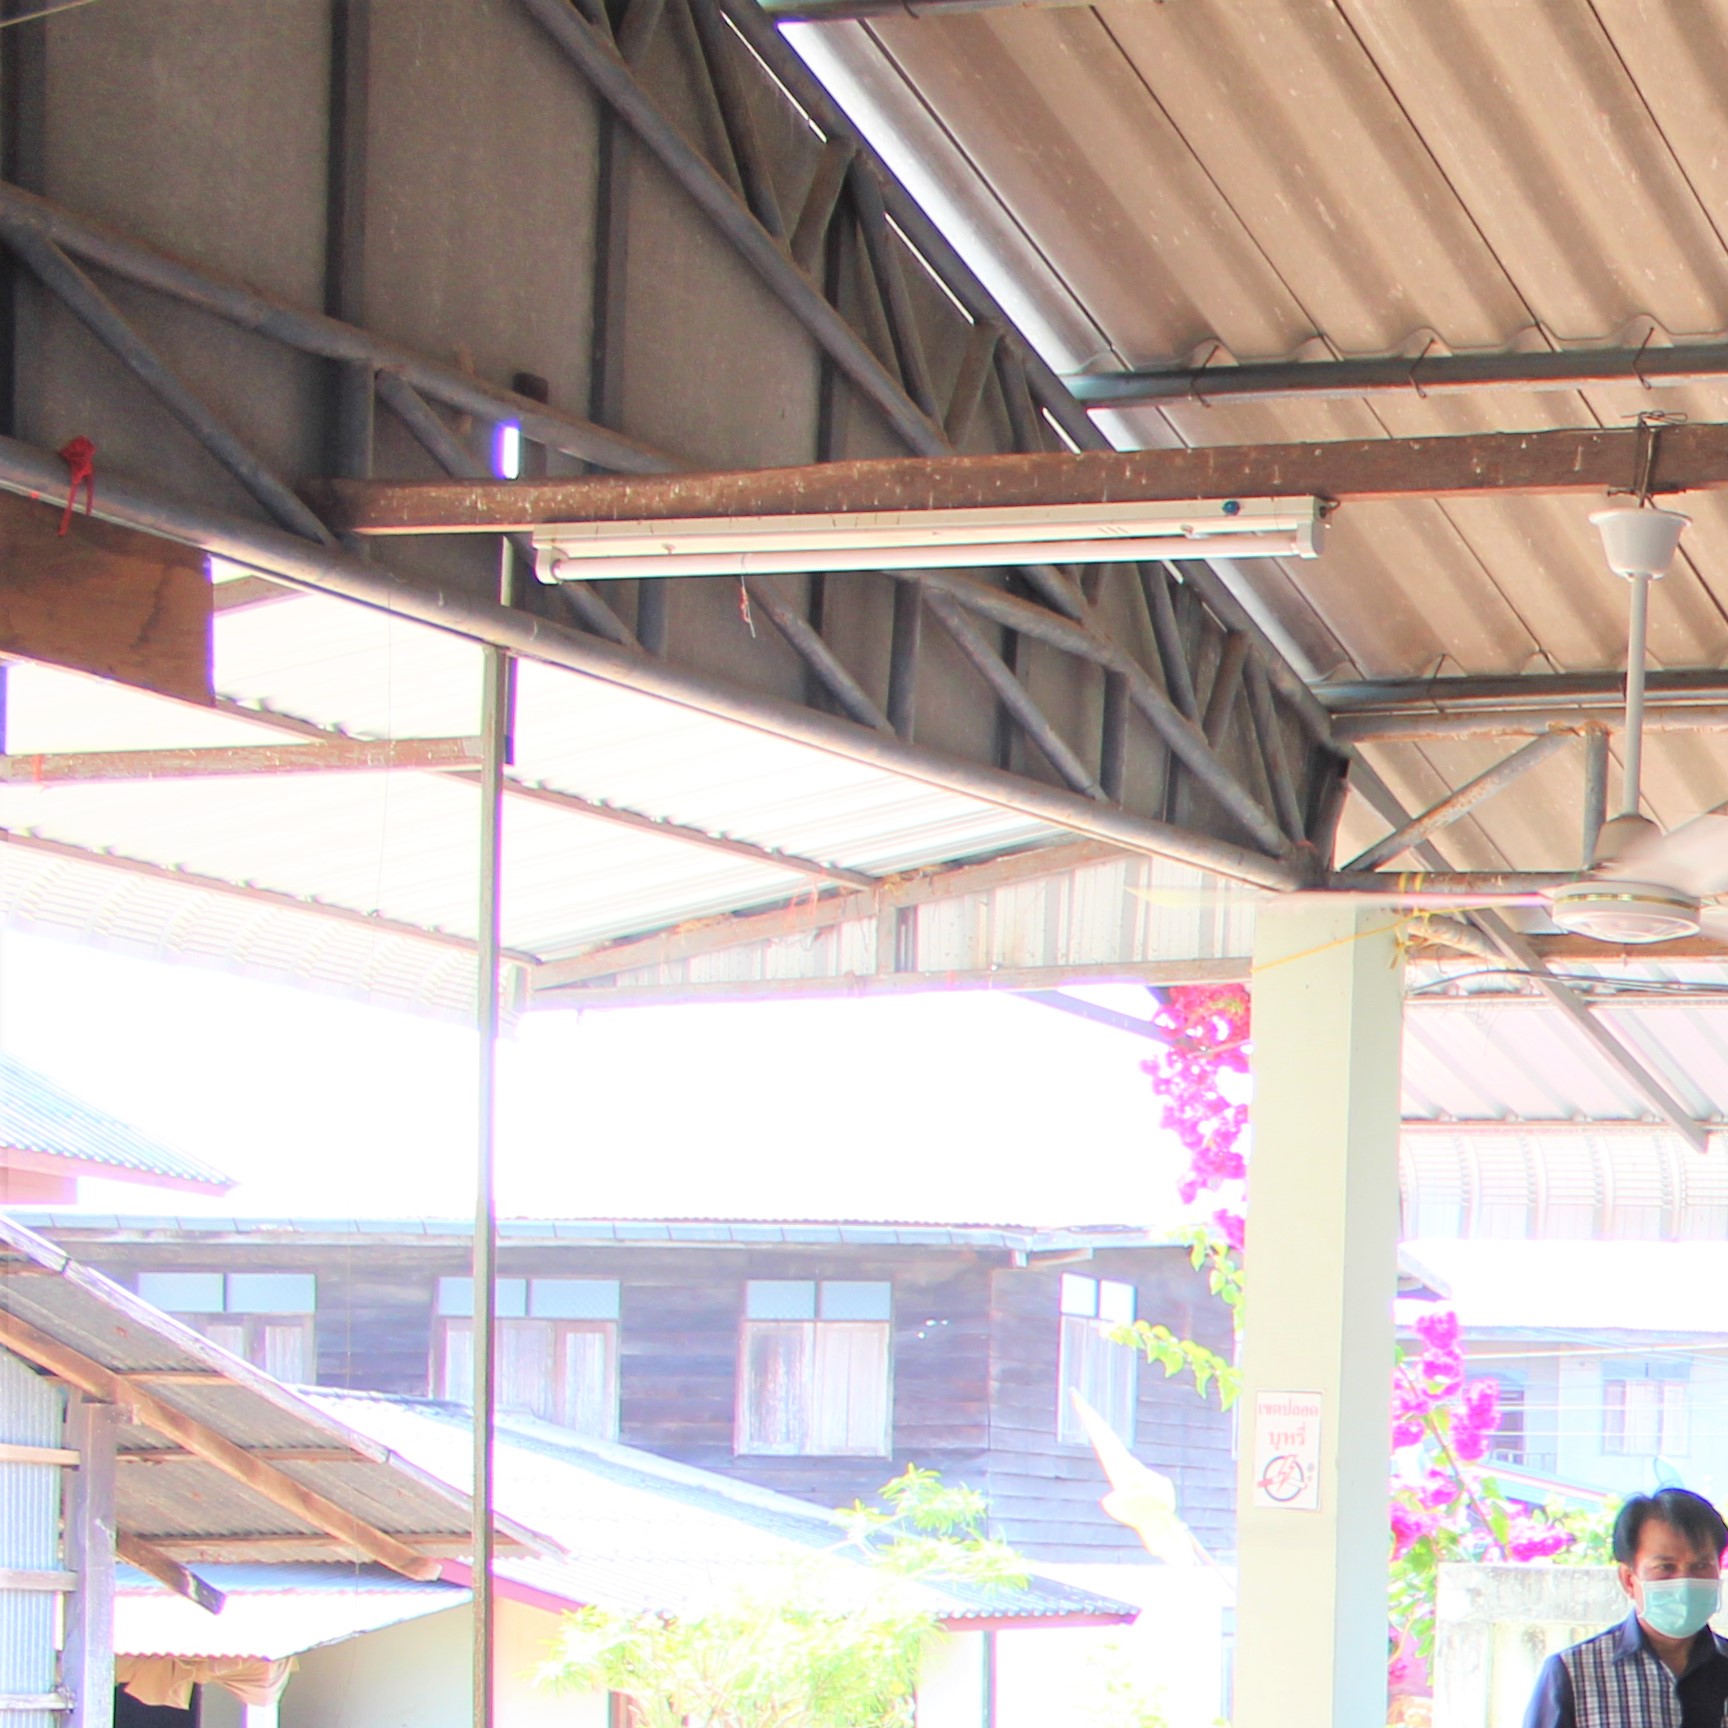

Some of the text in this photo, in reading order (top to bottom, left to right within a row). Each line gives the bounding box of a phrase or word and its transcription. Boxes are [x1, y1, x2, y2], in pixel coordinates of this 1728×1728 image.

[1257, 1398, 1320, 1418] เขตปลอด
[1267, 1421, 1307, 1452] บุหรี่
